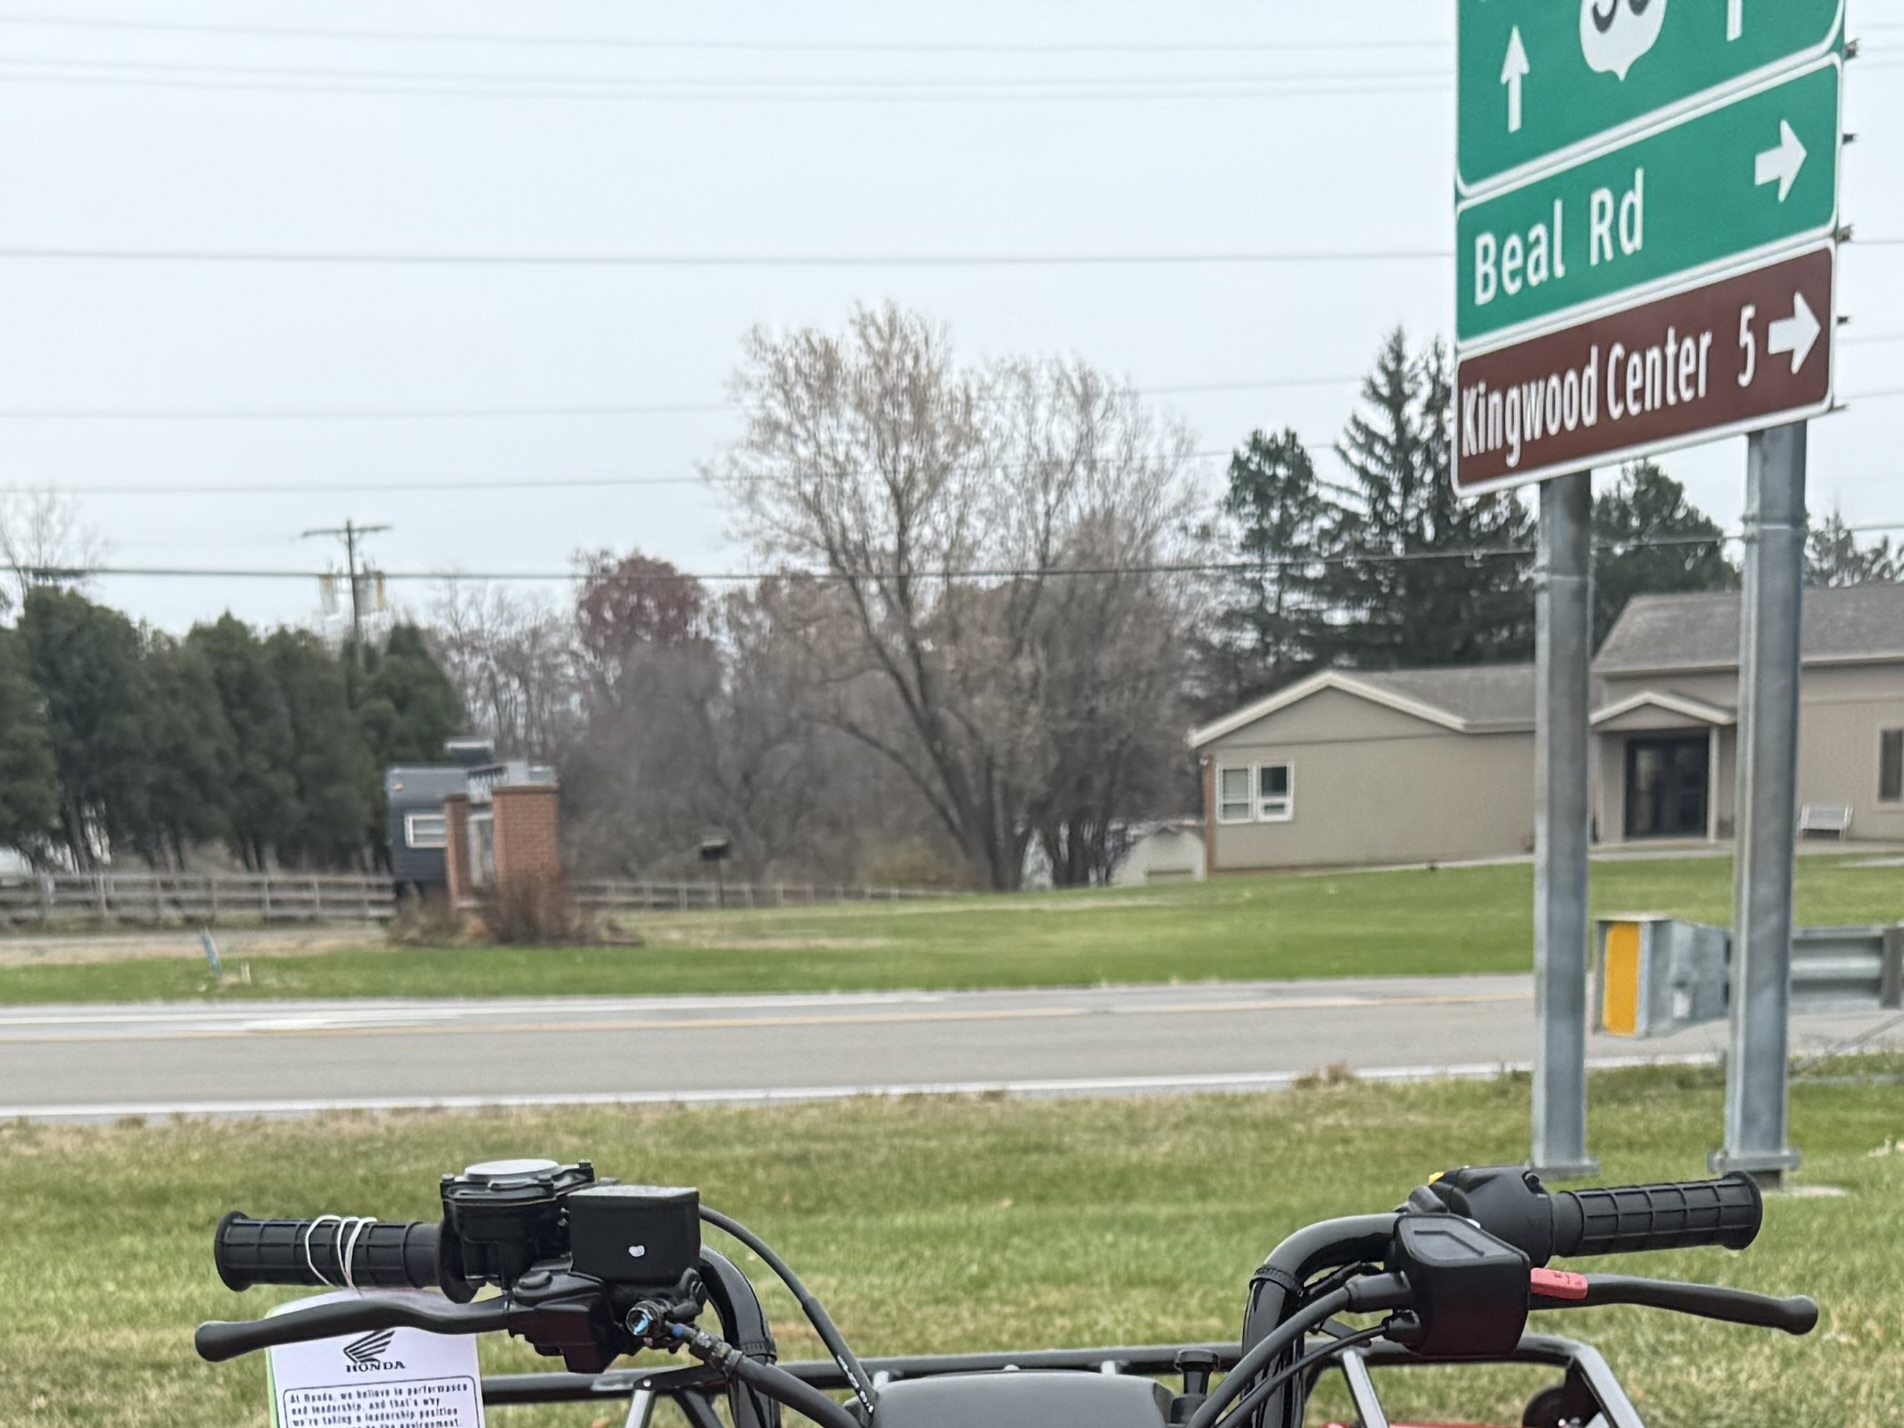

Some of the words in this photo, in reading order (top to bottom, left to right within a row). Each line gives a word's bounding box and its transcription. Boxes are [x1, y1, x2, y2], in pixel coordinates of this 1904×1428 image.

[1474, 198, 1565, 306] Beal
[1590, 167, 1645, 266] Rd
[1461, 345, 1598, 468] Kingwood
[1606, 325, 1713, 420] Center
[1737, 304, 1757, 388] 5
[345, 1361, 407, 1373] HONDA
